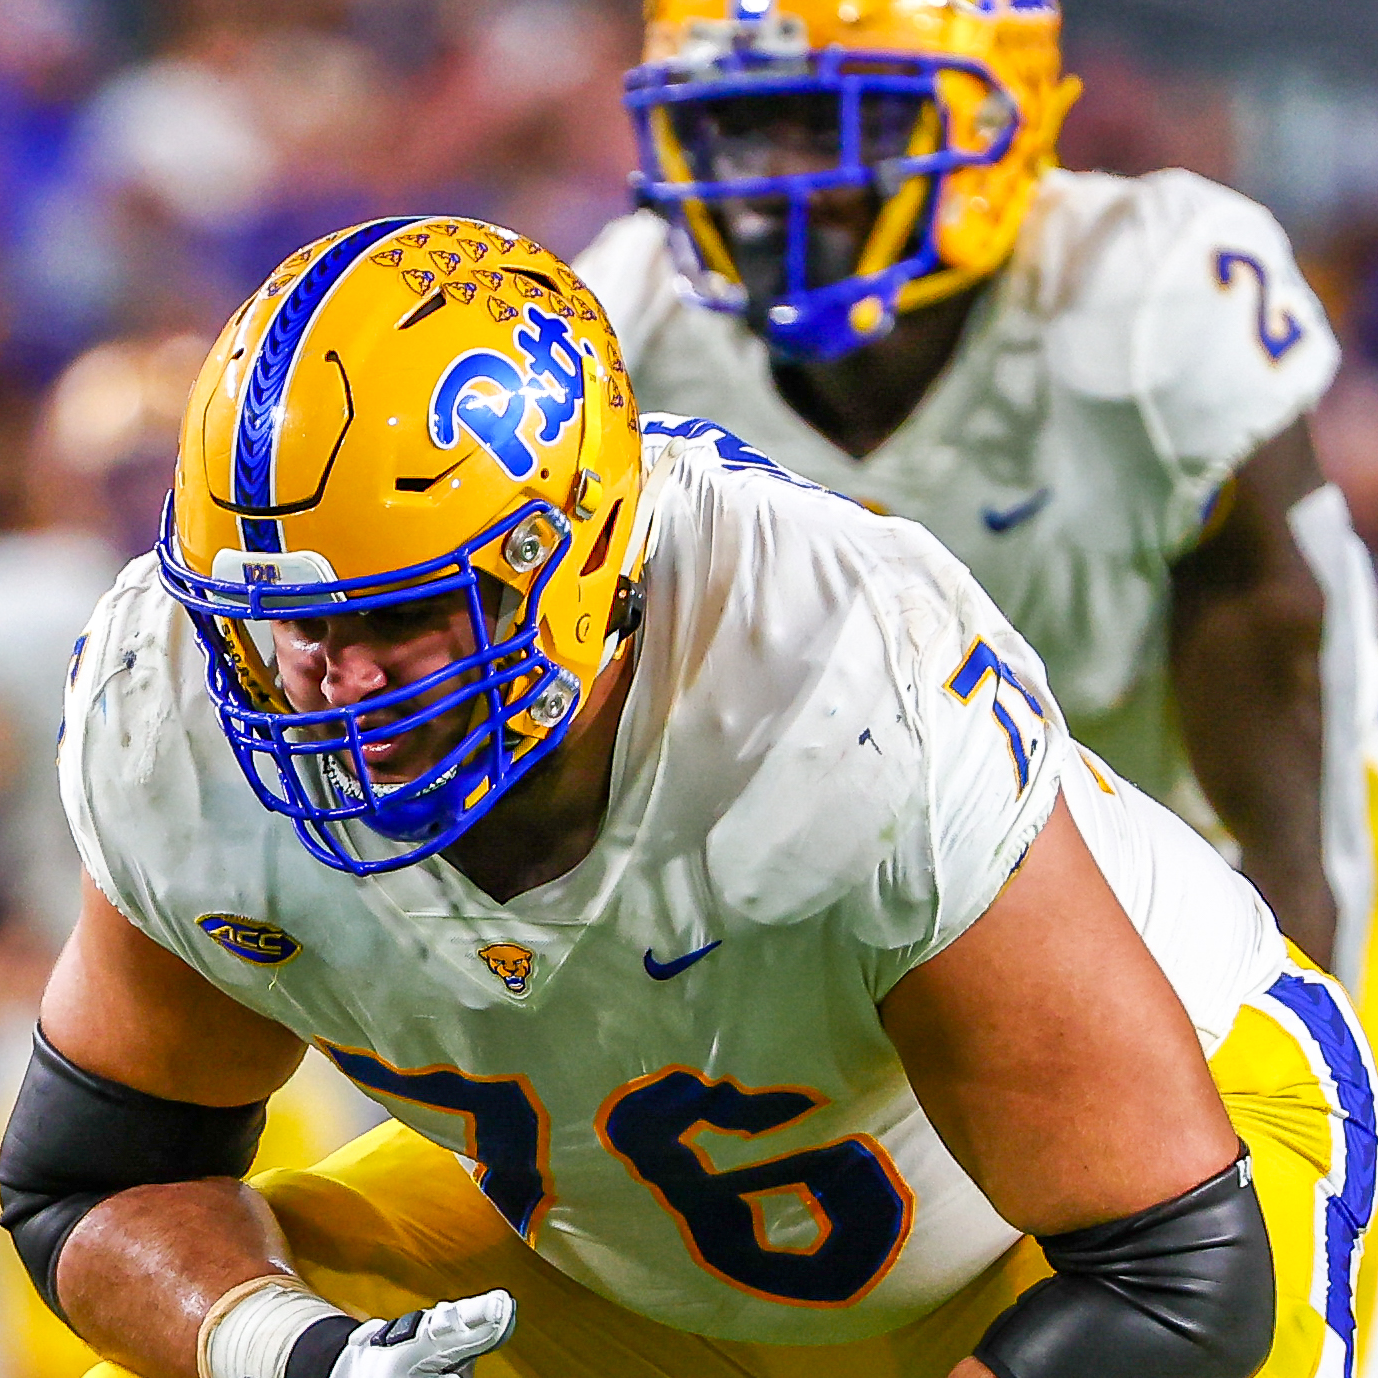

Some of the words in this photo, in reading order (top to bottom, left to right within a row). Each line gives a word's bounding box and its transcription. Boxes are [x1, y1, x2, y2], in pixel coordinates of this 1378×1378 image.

[1212, 247, 1304, 365] 2
[429, 302, 596, 482] Pitt
[206, 925, 283, 955] ACC
[315, 1035, 916, 1310] 76
